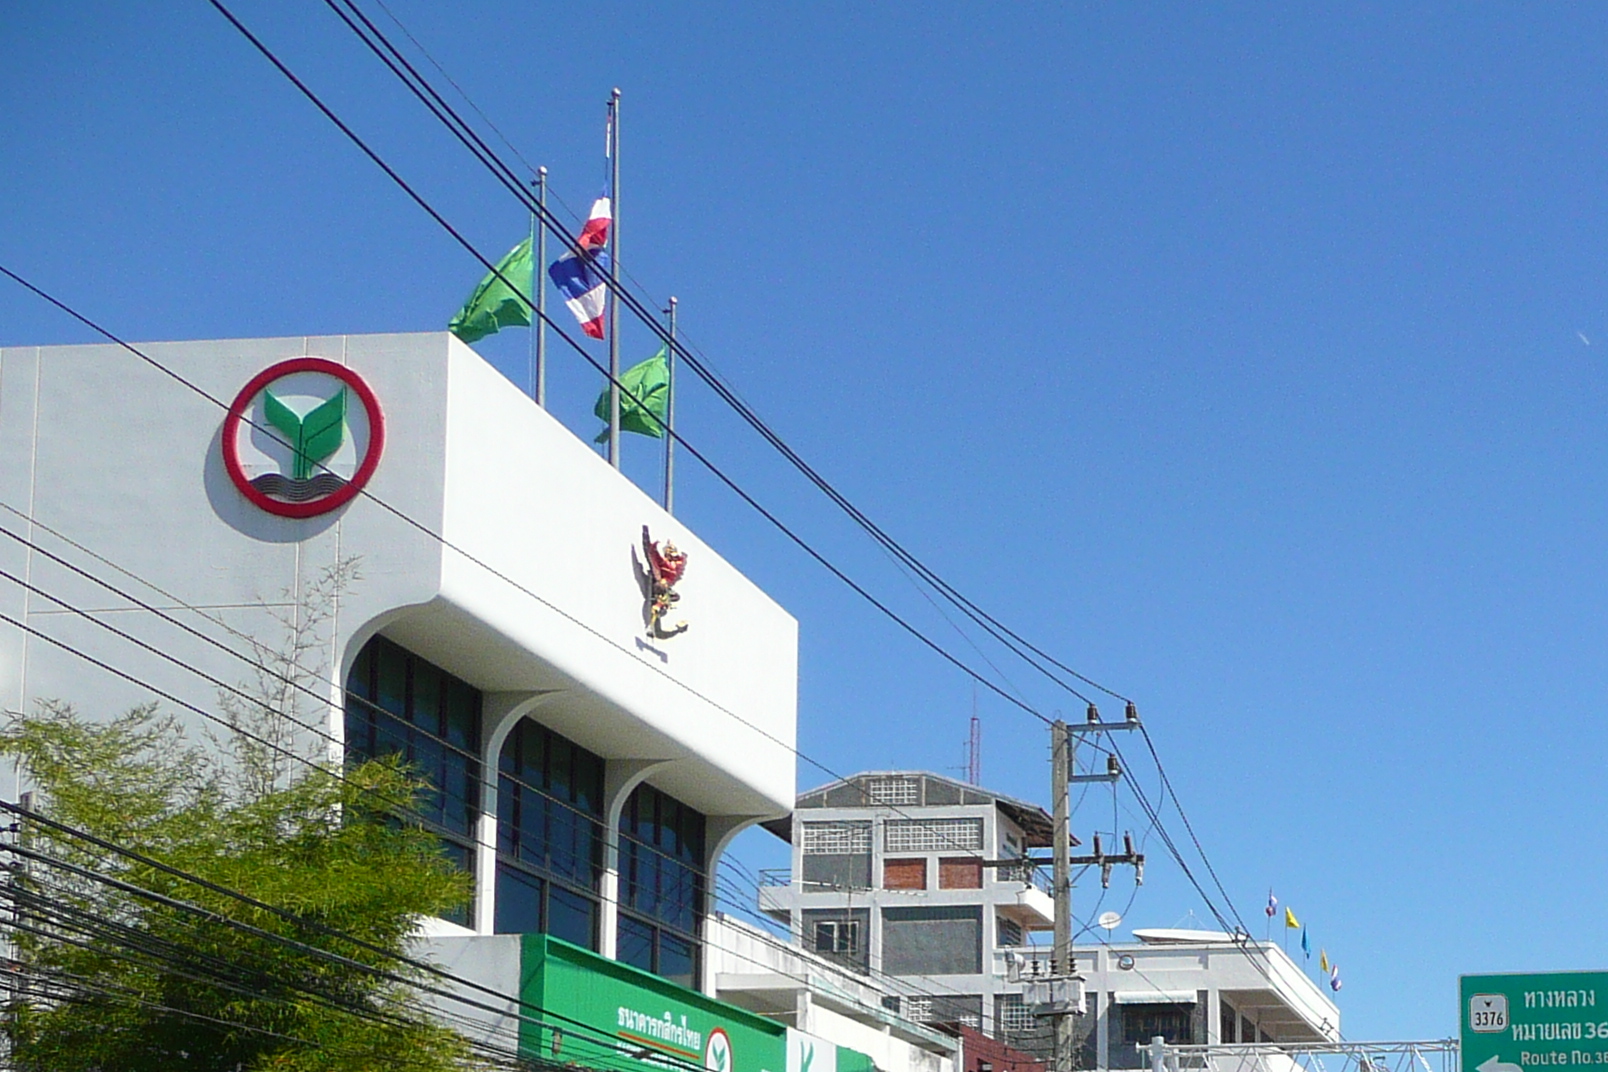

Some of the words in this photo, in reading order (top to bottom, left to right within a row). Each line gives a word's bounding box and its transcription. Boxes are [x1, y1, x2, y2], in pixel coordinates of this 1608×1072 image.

[1524, 990, 1595, 1008] ทางหลวง
[618, 1006, 701, 1050] ธนาคารกสิกรไทย
[1474, 1012, 1504, 1026] 3376
[1512, 1022, 1581, 1041] หมายเลข
[1521, 1051, 1567, 1065] Route
